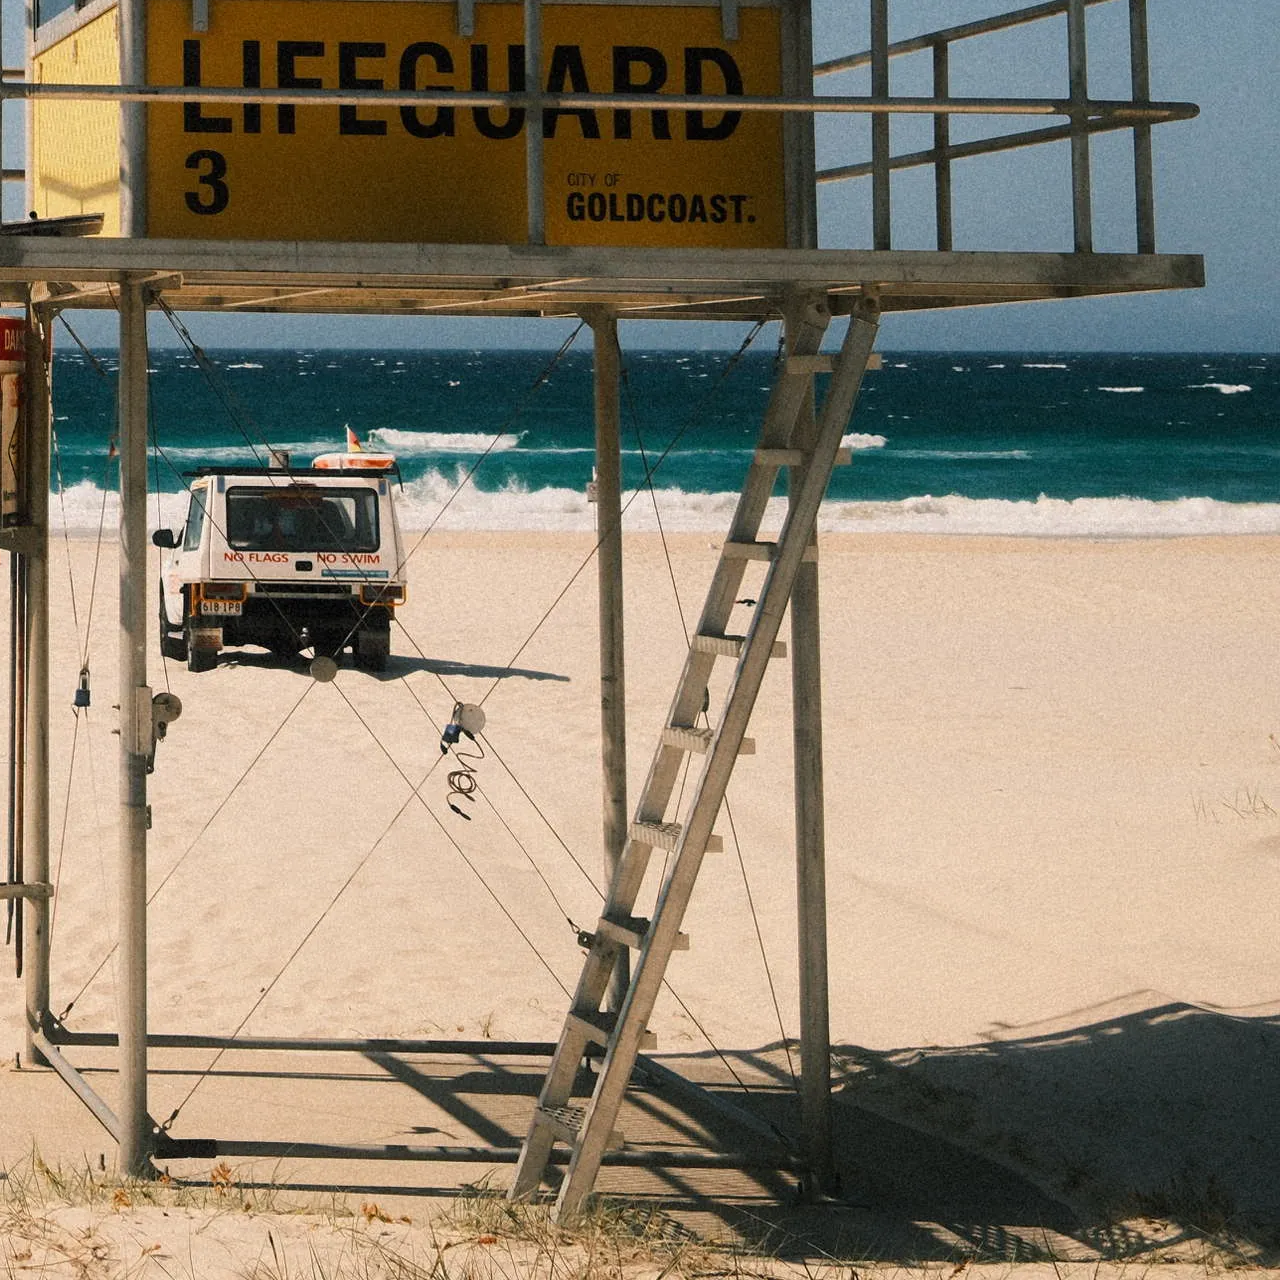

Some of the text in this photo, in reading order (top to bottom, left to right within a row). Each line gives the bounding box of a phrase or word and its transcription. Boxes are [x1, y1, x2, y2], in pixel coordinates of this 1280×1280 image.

[183, 39, 745, 141] LIFEGUARD
[184, 149, 230, 215] 3
[567, 173, 622, 187] CITY OF
[224, 552, 380, 564] NO FLAGS NO SWIM
